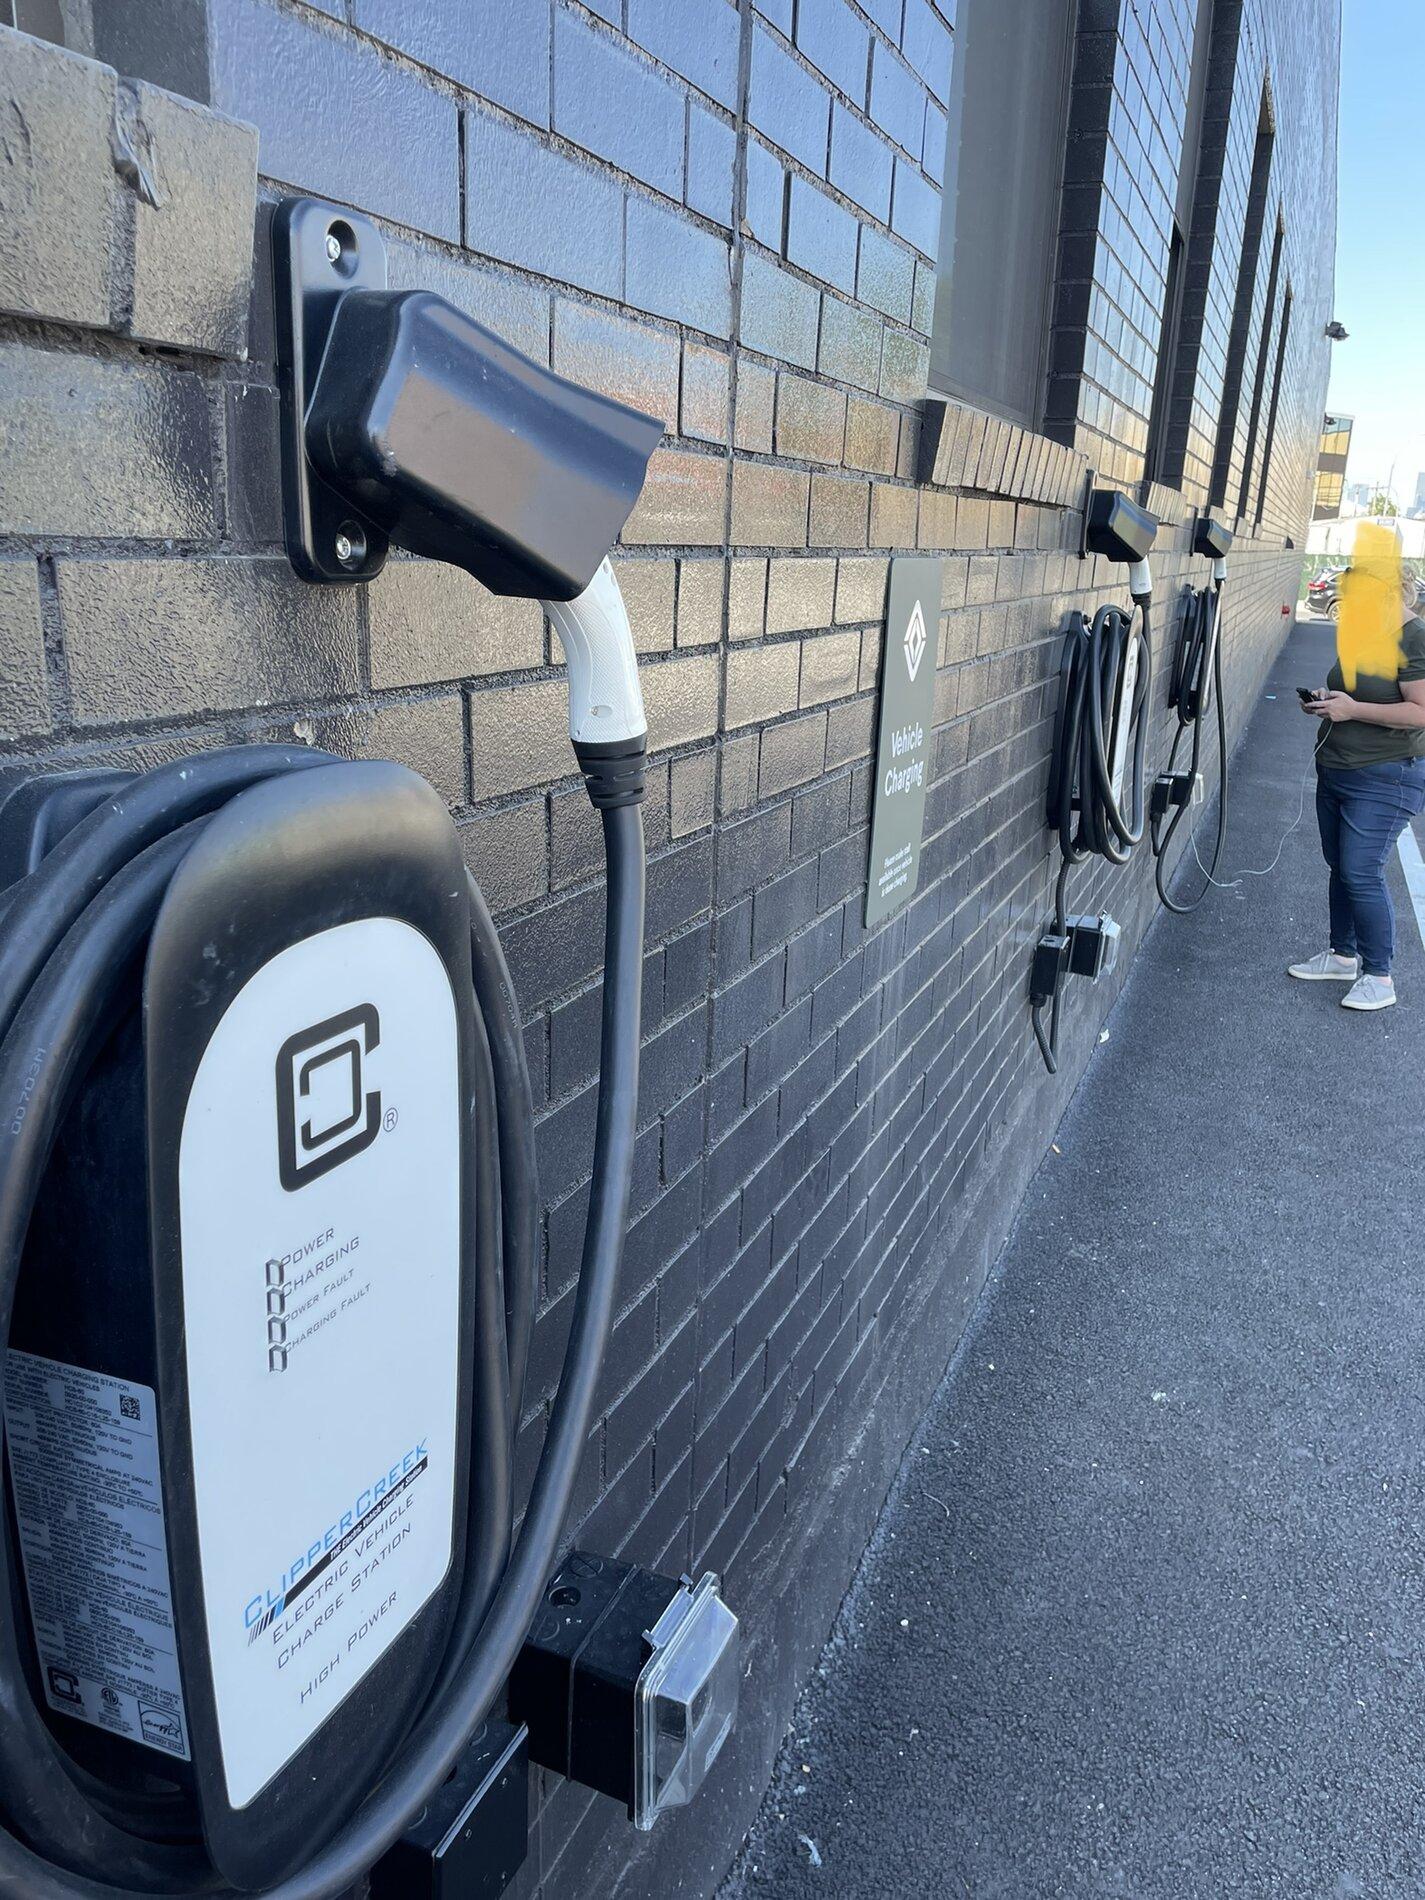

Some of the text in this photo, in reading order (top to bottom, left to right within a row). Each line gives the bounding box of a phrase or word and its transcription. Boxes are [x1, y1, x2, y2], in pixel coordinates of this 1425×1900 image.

[891, 722, 923, 758] Vehicle
[884, 757, 924, 797] Charging
[281, 1228, 335, 1267] POWER
[281, 1236, 360, 1298] CHARGING
[283, 1268, 354, 1323] POWER FAULT
[284, 1284, 371, 1354] CHARGING FAULT
[7, 1352, 129, 1392] ECTRIC VEHICLE CHARGING STATION
[43, 1370, 70, 1384] ELECTRIC
[273, 1493, 414, 1645] ELECTRIC VEHICLE
[278, 1522, 411, 1669] CHARGE STATION
[300, 1591, 397, 1704] HIGH POWER
